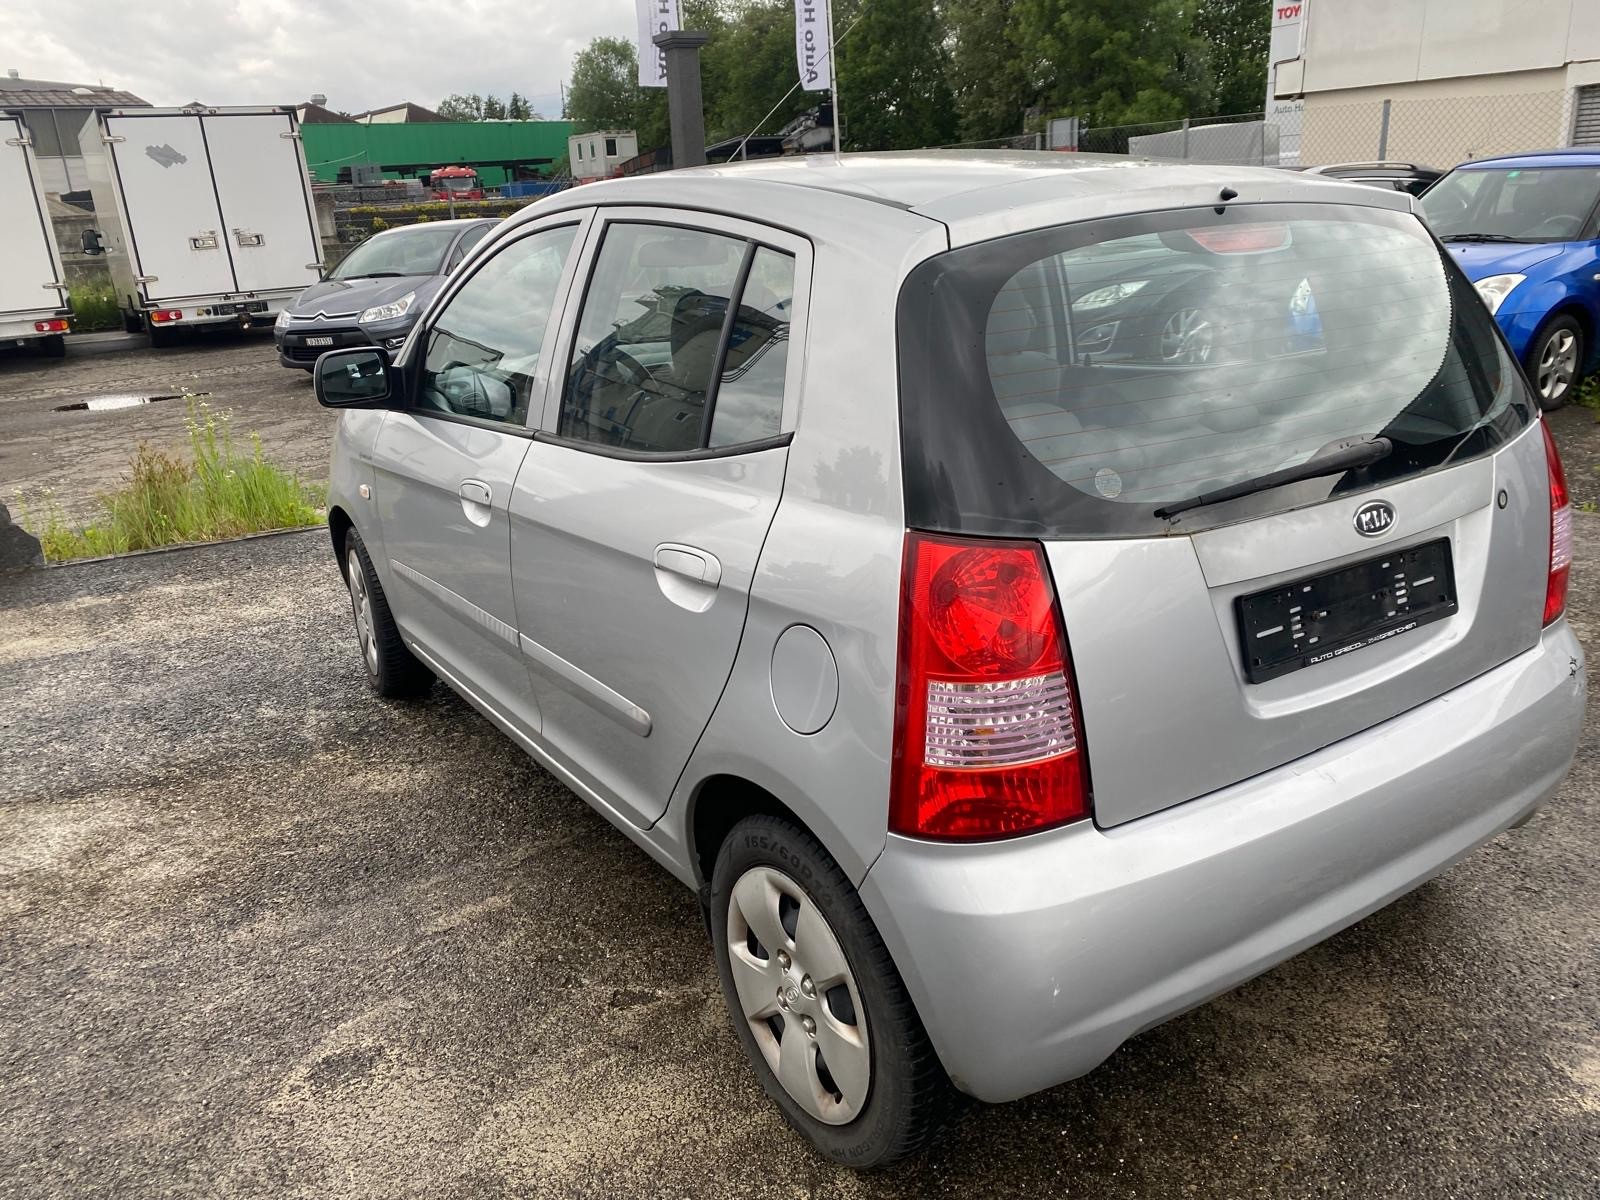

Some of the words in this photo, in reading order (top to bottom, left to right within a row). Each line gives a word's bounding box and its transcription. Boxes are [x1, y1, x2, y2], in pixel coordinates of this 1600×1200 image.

[1273, 105, 1293, 114] Auto
[1360, 508, 1391, 531] KIA
[1310, 652, 1333, 663] AUTO
[1334, 642, 1361, 656] GRECO
